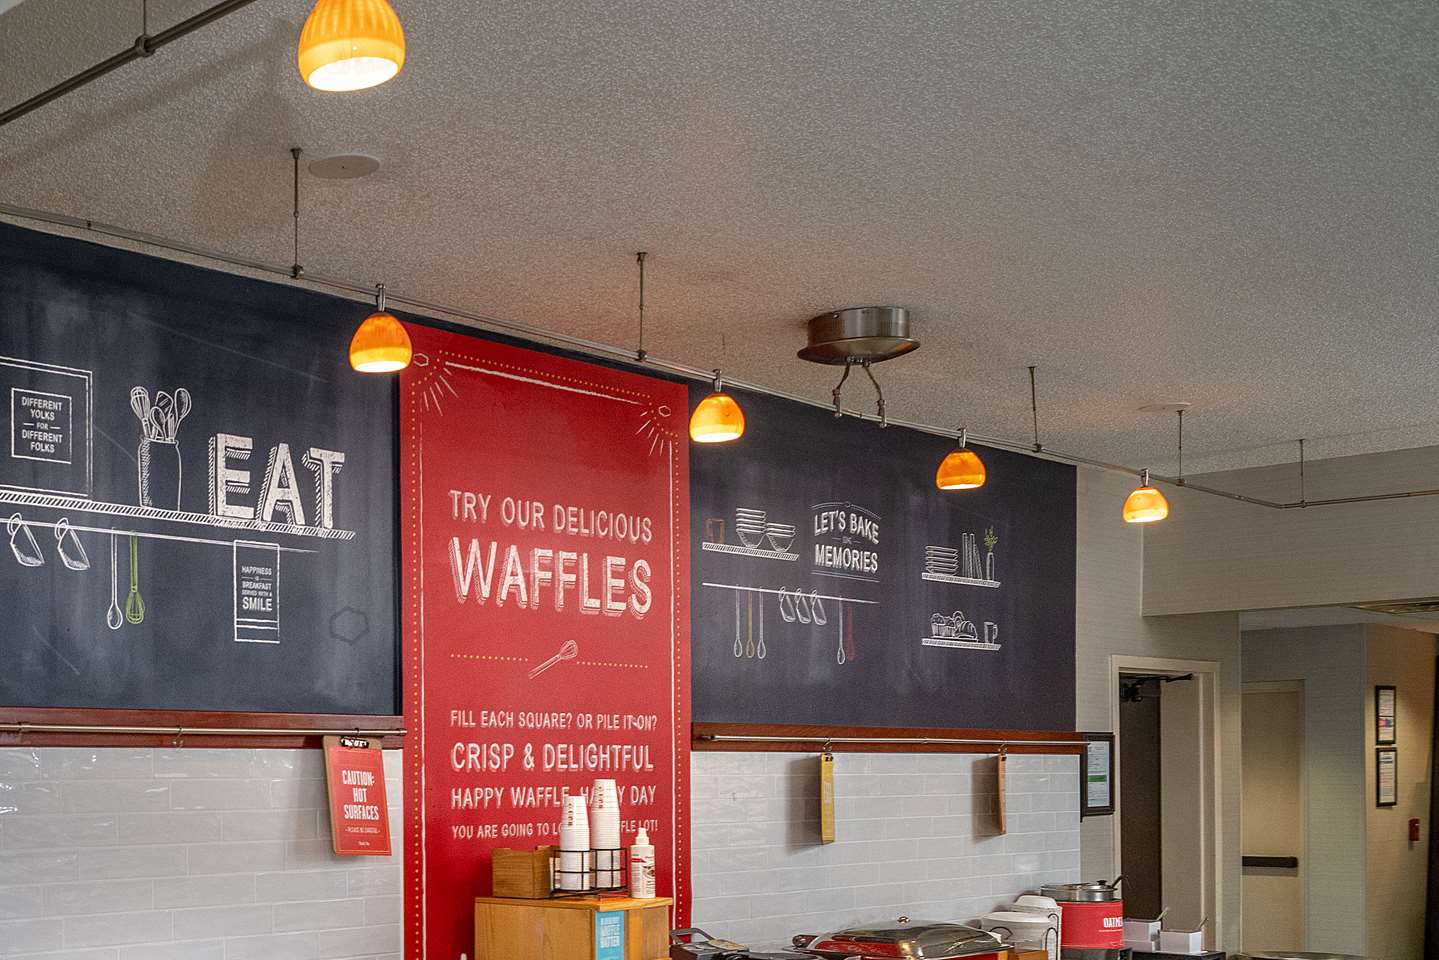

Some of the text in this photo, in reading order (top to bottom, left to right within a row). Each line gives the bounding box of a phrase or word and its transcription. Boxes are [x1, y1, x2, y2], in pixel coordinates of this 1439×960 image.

[21, 396, 62, 411] DIFFERENT
[30, 408, 55, 421] YOLKS
[36, 422, 49, 430] FOR
[21, 429, 62, 443] DIFFERENT
[30, 441, 55, 453] FOLKS
[209, 433, 345, 529] EAT
[449, 489, 653, 544] TRY OUR DELICIOUS
[814, 510, 879, 544] LET'S BAKE
[815, 544, 878, 573] MEMORIES
[241, 565, 272, 576] HAPPINESS
[449, 536, 653, 620] WAFFLES
[242, 581, 272, 590] BREAKFAST
[242, 596, 272, 611] SMILE
[451, 710, 476, 728] FILL
[481, 710, 514, 728] EACH
[518, 711, 573, 729] SQUARE?
[577, 713, 593, 729] OR
[597, 713, 620, 730] PILE
[451, 742, 654, 772] CRISP & DELIGHTFUL
[342, 770, 375, 786] CAUTION:
[353, 788, 367, 803] HOT
[451, 786, 504, 809] HAPPY
[510, 786, 570, 809] WAFFLE
[630, 785, 656, 806] DAY
[344, 804, 379, 821] SURFACES
[452, 824, 478, 839] YOU
[480, 824, 498, 838] ARE
[501, 823, 533, 838] GOING
[537, 822, 549, 837] TO
